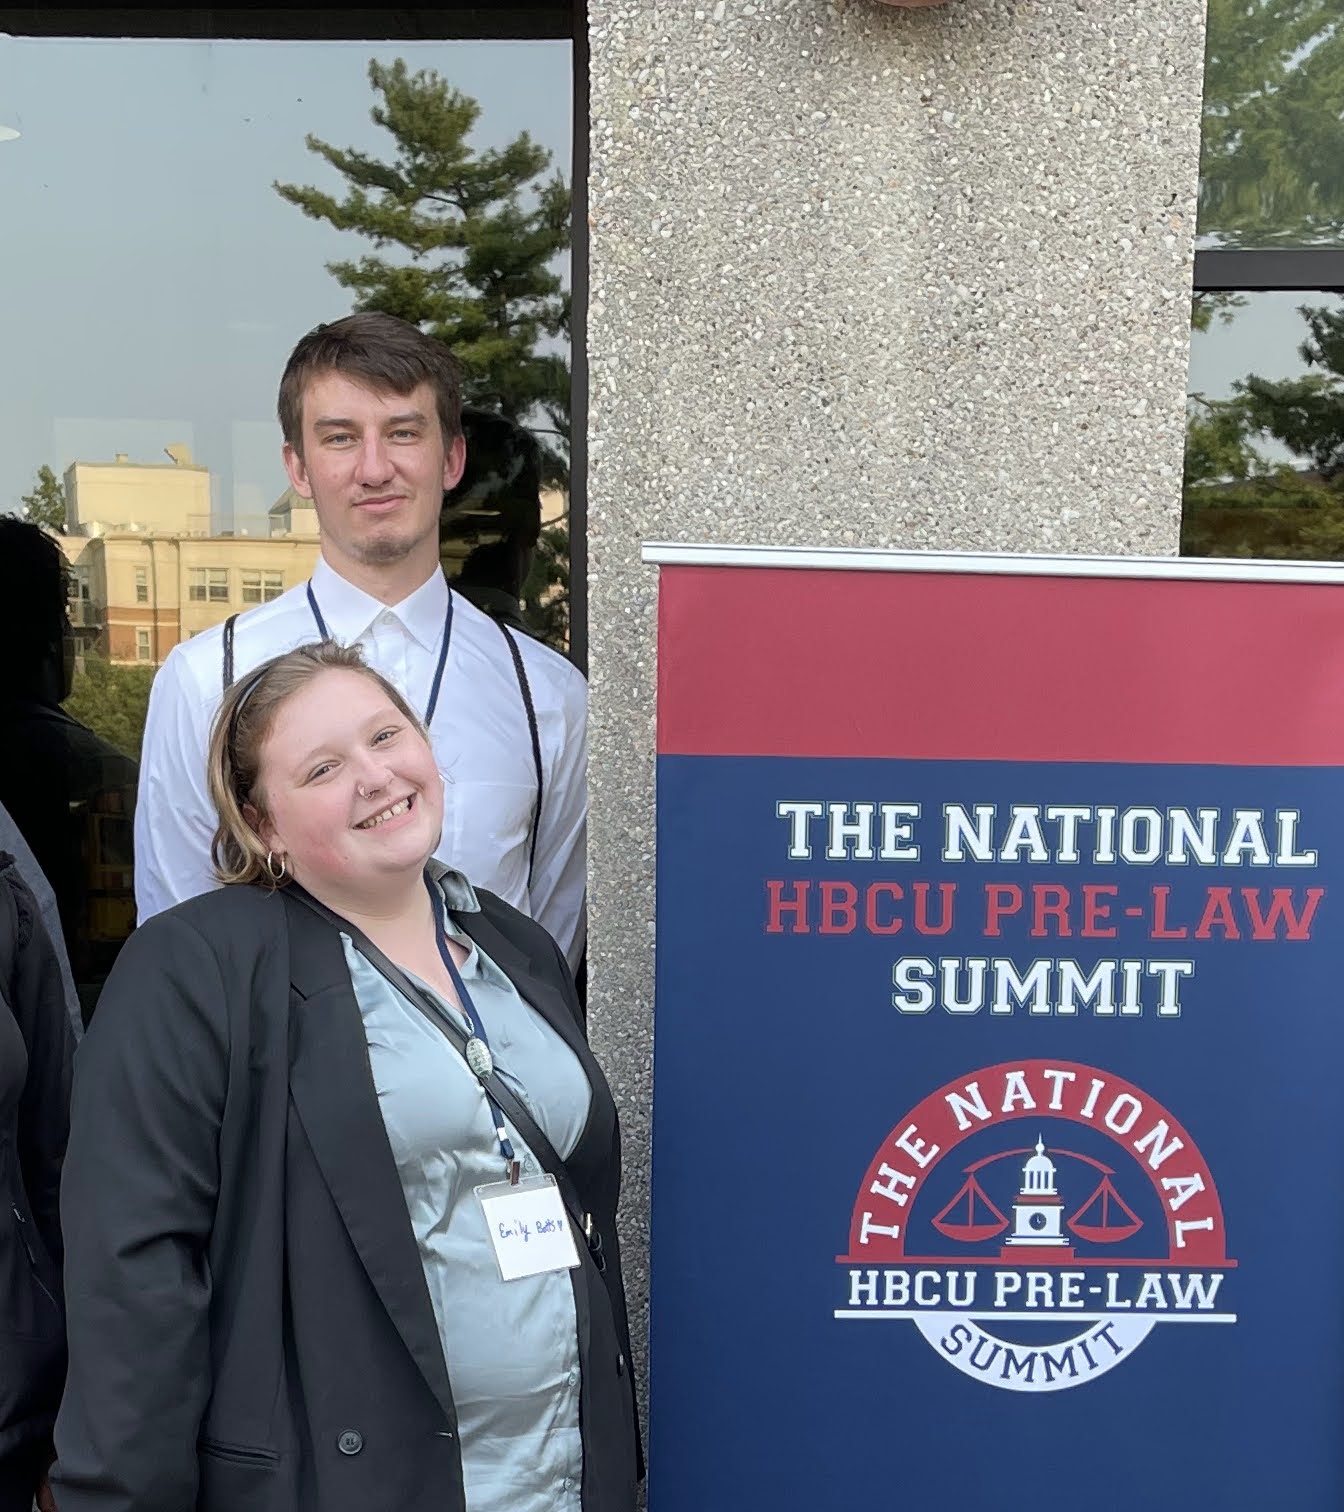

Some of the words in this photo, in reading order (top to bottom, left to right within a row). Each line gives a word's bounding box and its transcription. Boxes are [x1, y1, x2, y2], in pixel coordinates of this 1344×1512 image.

[776, 801, 921, 861] THE
[942, 804, 1318, 867] NATIONAL
[765, 880, 958, 937] HBCU
[983, 883, 1325, 942] PRE-LAW
[892, 957, 1194, 1017] SUMMIT
[859, 1122, 940, 1245] THE
[944, 1069, 1214, 1248] NATIONAL
[498, 1219, 532, 1243] Emily
[848, 1269, 978, 1306] HBCU
[993, 1271, 1225, 1309] PRE-LAW
[940, 1321, 1124, 1384] SUMMIT
